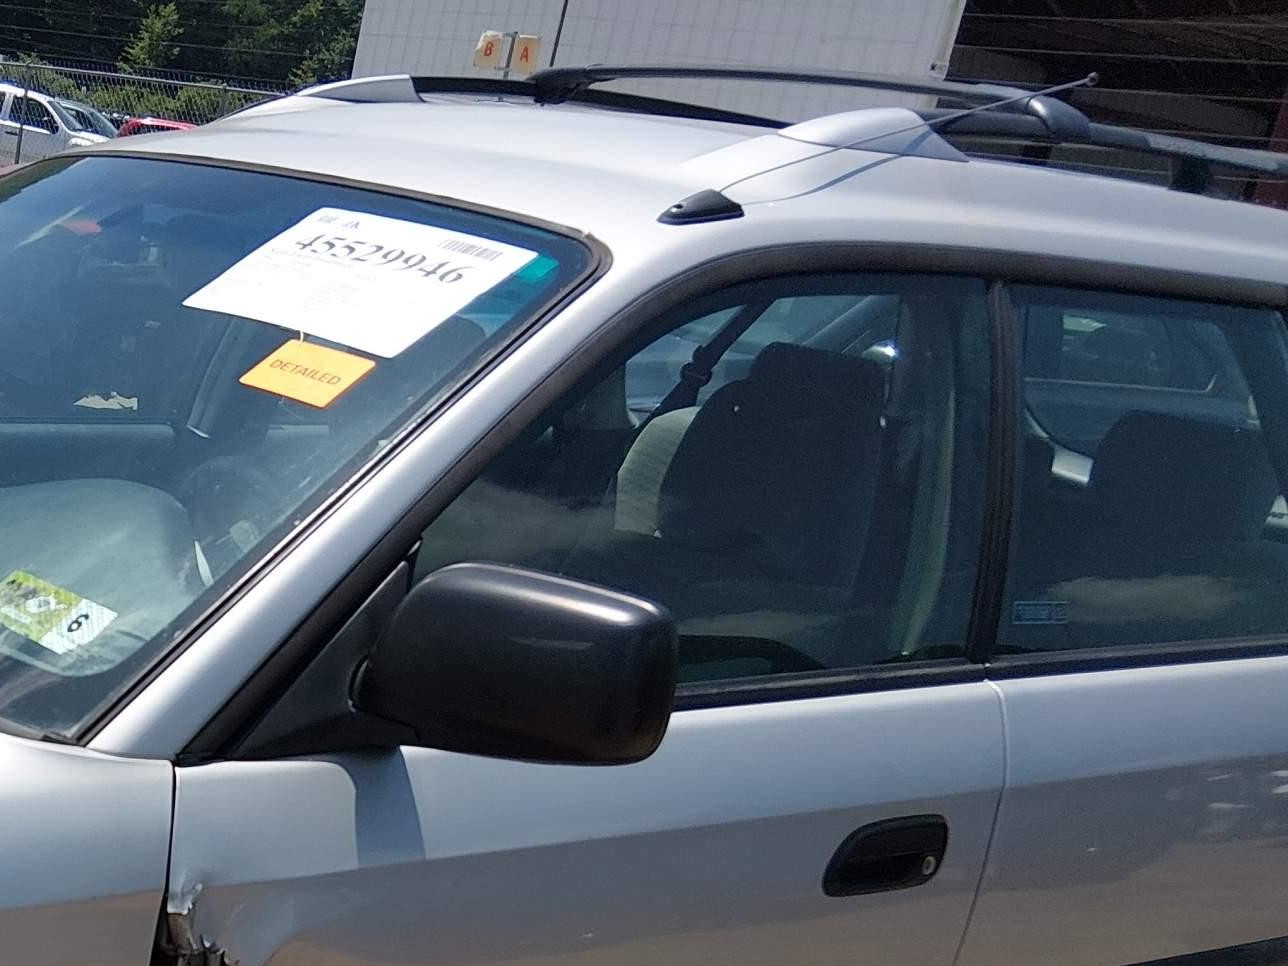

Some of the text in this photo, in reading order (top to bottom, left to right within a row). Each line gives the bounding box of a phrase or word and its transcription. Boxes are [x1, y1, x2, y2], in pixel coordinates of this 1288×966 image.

[484, 42, 494, 56] B
[520, 47, 529, 62] A
[296, 233, 477, 283] 45529946
[269, 359, 342, 385] DETAILED
[67, 614, 89, 632] 6
